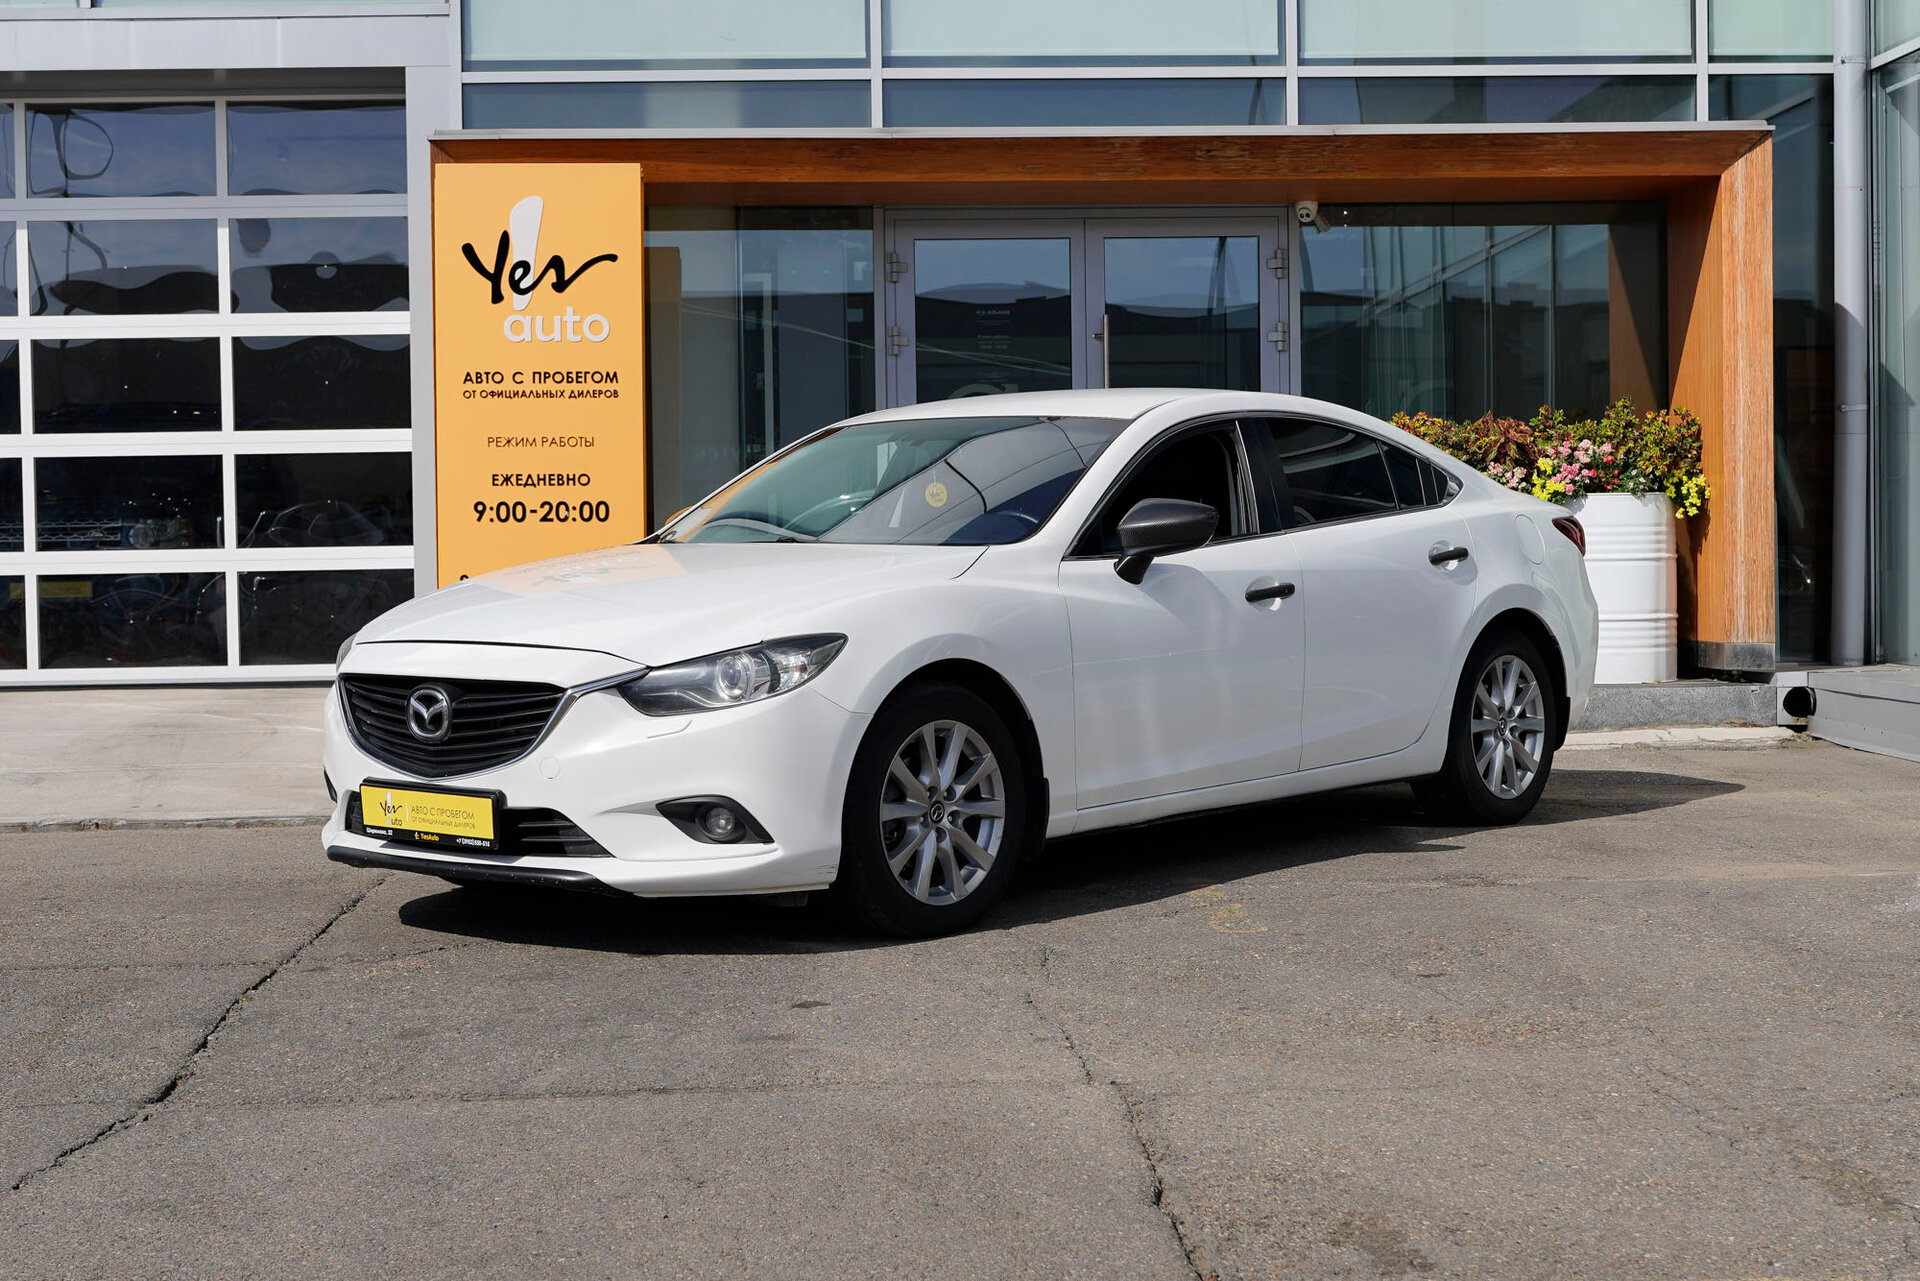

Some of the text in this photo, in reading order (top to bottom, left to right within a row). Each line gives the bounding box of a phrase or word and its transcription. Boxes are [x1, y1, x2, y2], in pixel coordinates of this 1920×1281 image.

[461, 229, 619, 305] Yes
[503, 306, 611, 343] auto
[462, 370, 620, 385] АВТО С ПРОБЕГОМ
[462, 389, 620, 400] ОТ ОФИЦИАЛЬНЫХ ДИЛЕРОВ
[487, 436, 595, 448] РЕЖИМ РАБОТЫ
[491, 473, 591, 489] ЕЖЕДНЕВНО
[473, 500, 611, 524] 9:00-20:00
[379, 800, 402, 816] Yes
[411, 805, 475, 820] АВТО С ПРОБЕГОМ
